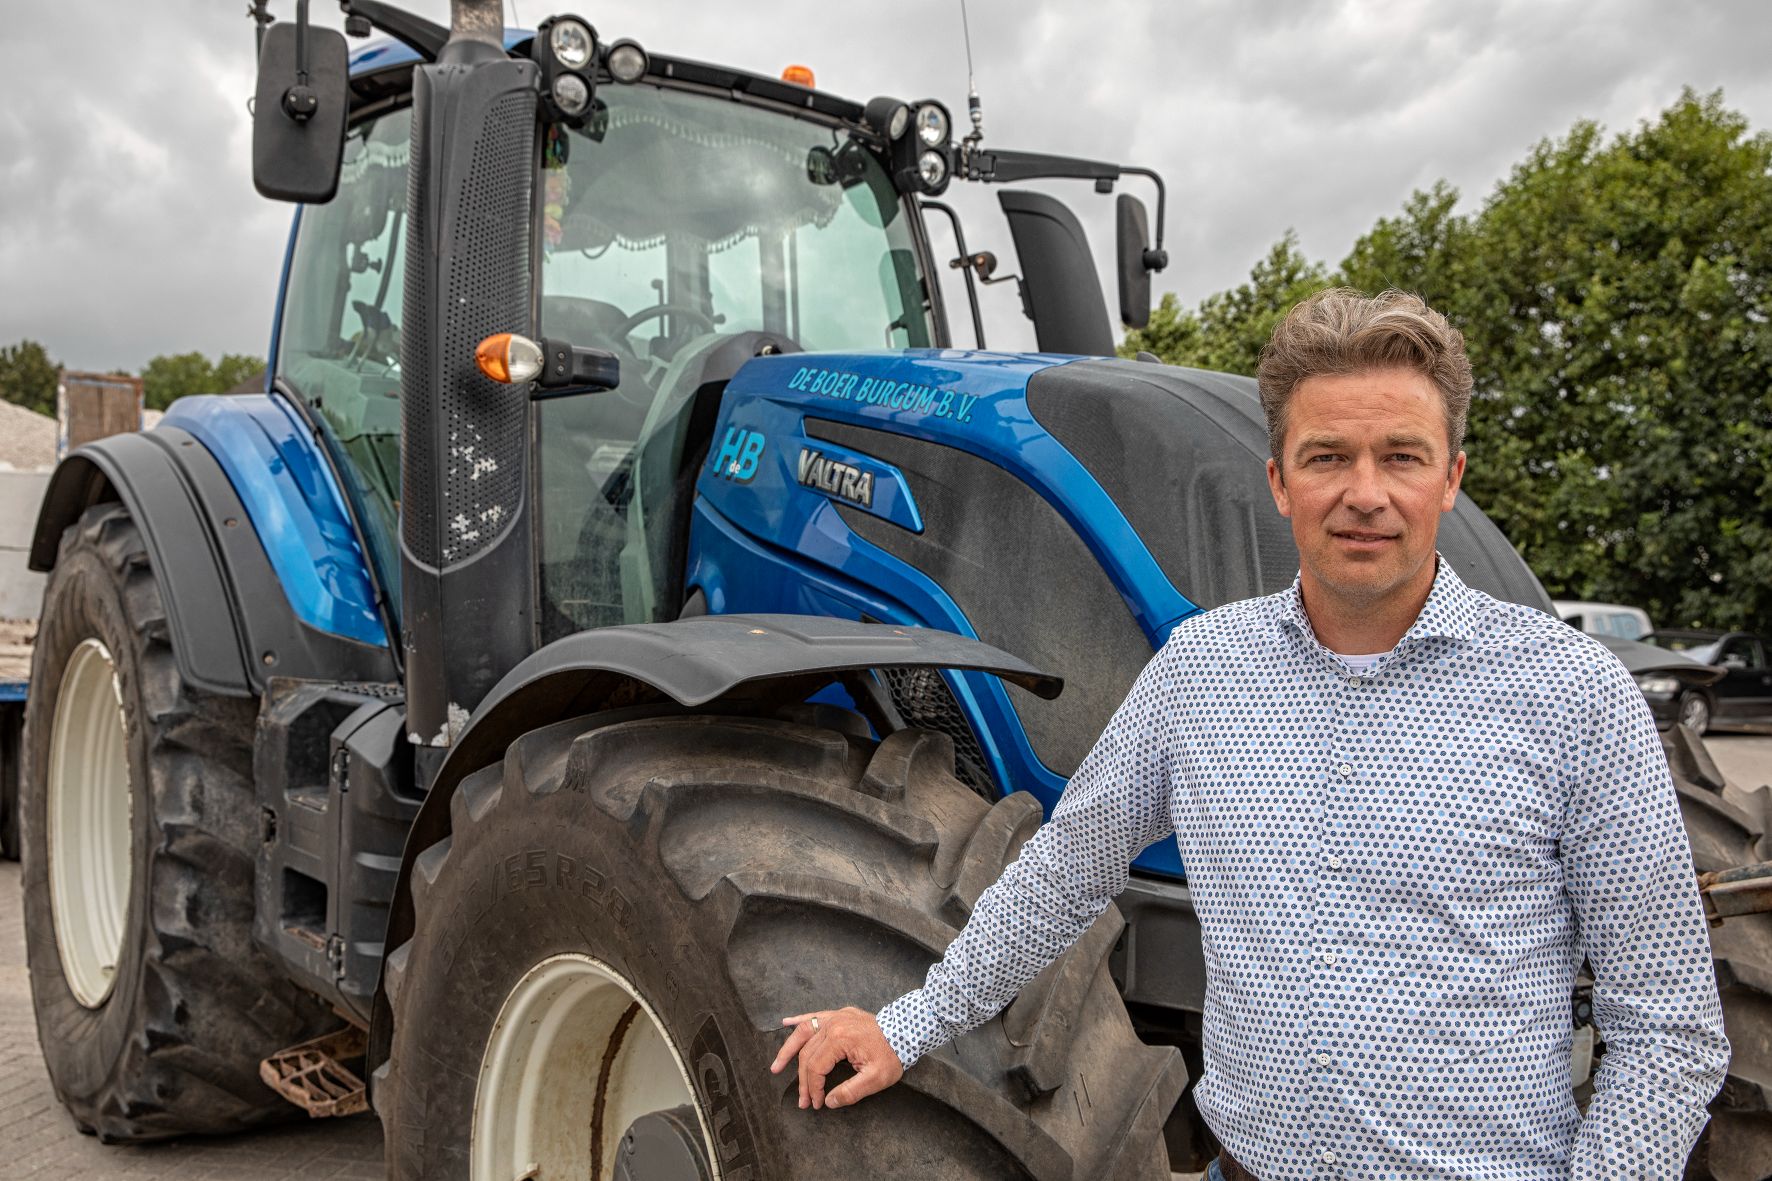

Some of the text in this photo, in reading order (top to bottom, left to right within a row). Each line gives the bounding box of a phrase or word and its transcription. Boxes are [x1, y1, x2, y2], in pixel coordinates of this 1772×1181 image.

[788, 366, 980, 424] DE BOER BURGUM B.V.
[712, 426, 766, 484] HB
[728, 460, 742, 474] de
[798, 448, 874, 508] VALTRA
